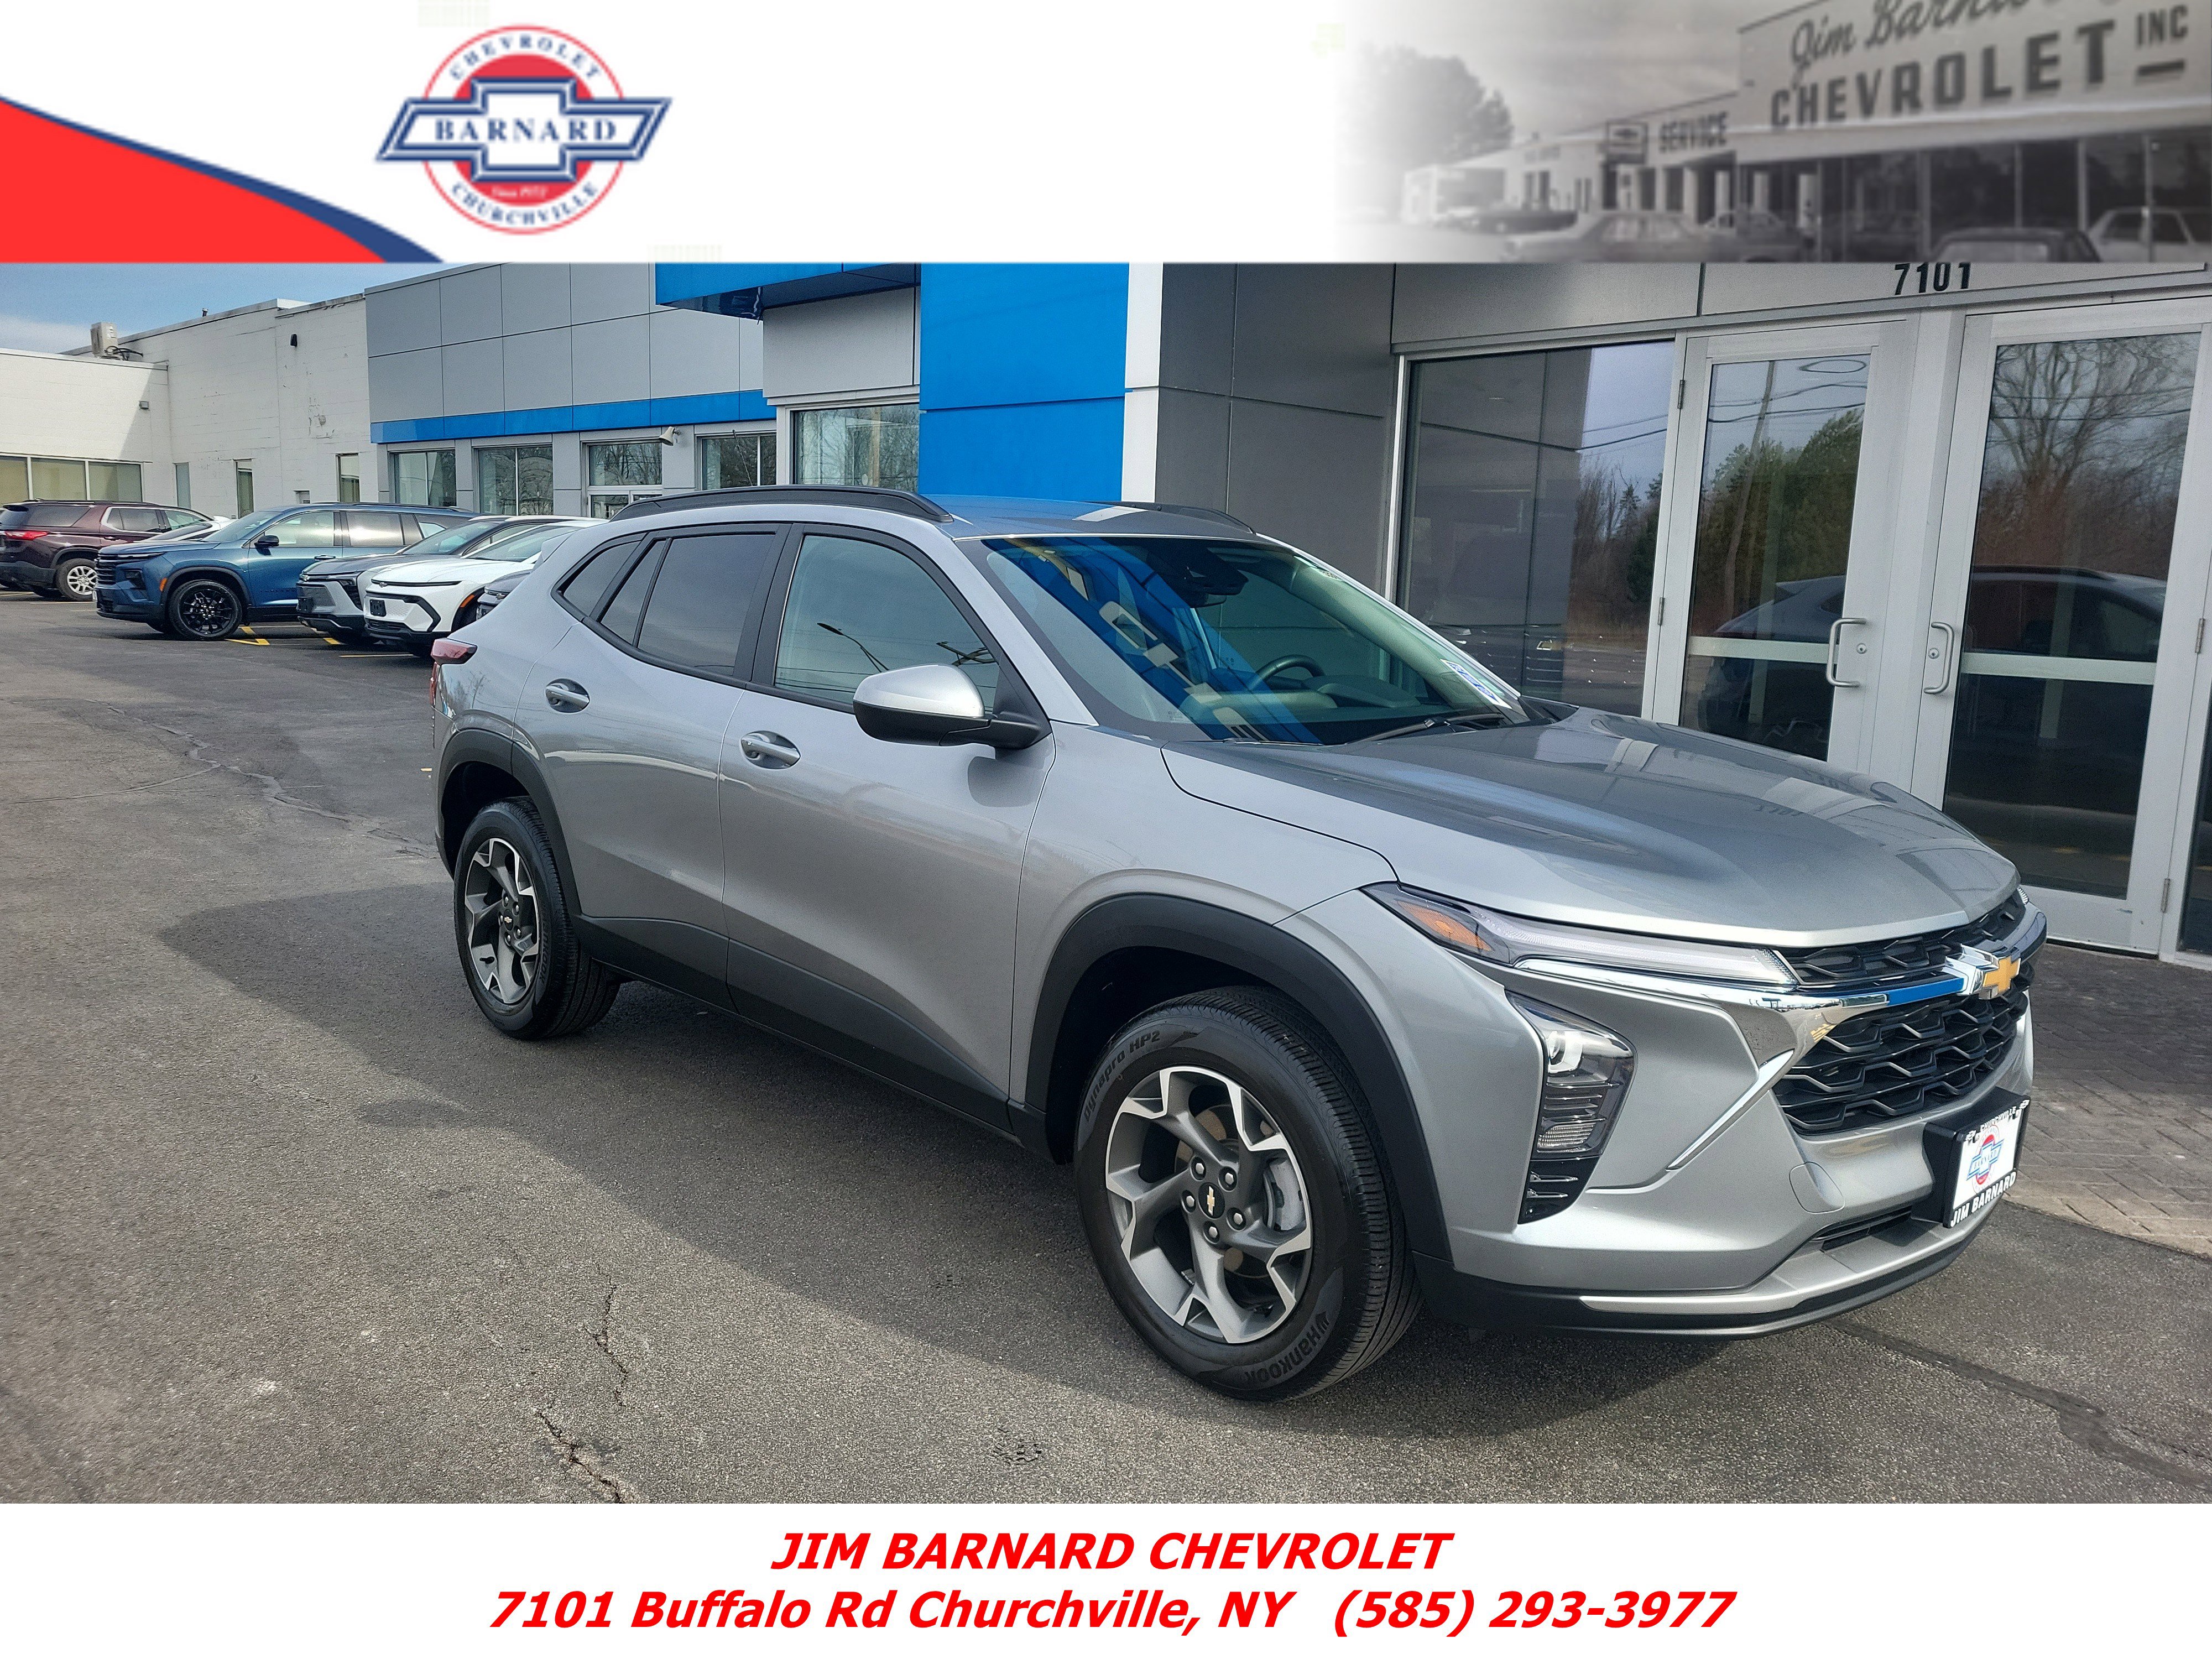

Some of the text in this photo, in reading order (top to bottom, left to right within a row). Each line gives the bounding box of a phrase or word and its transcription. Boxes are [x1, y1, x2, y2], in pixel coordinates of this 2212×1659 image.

[1895, 262, 1971, 295] 7101
[1129, 1030, 1160, 1053] HP2
[1950, 1202, 1970, 1228] JIM
[1971, 1171, 2017, 1213] BARNARD
